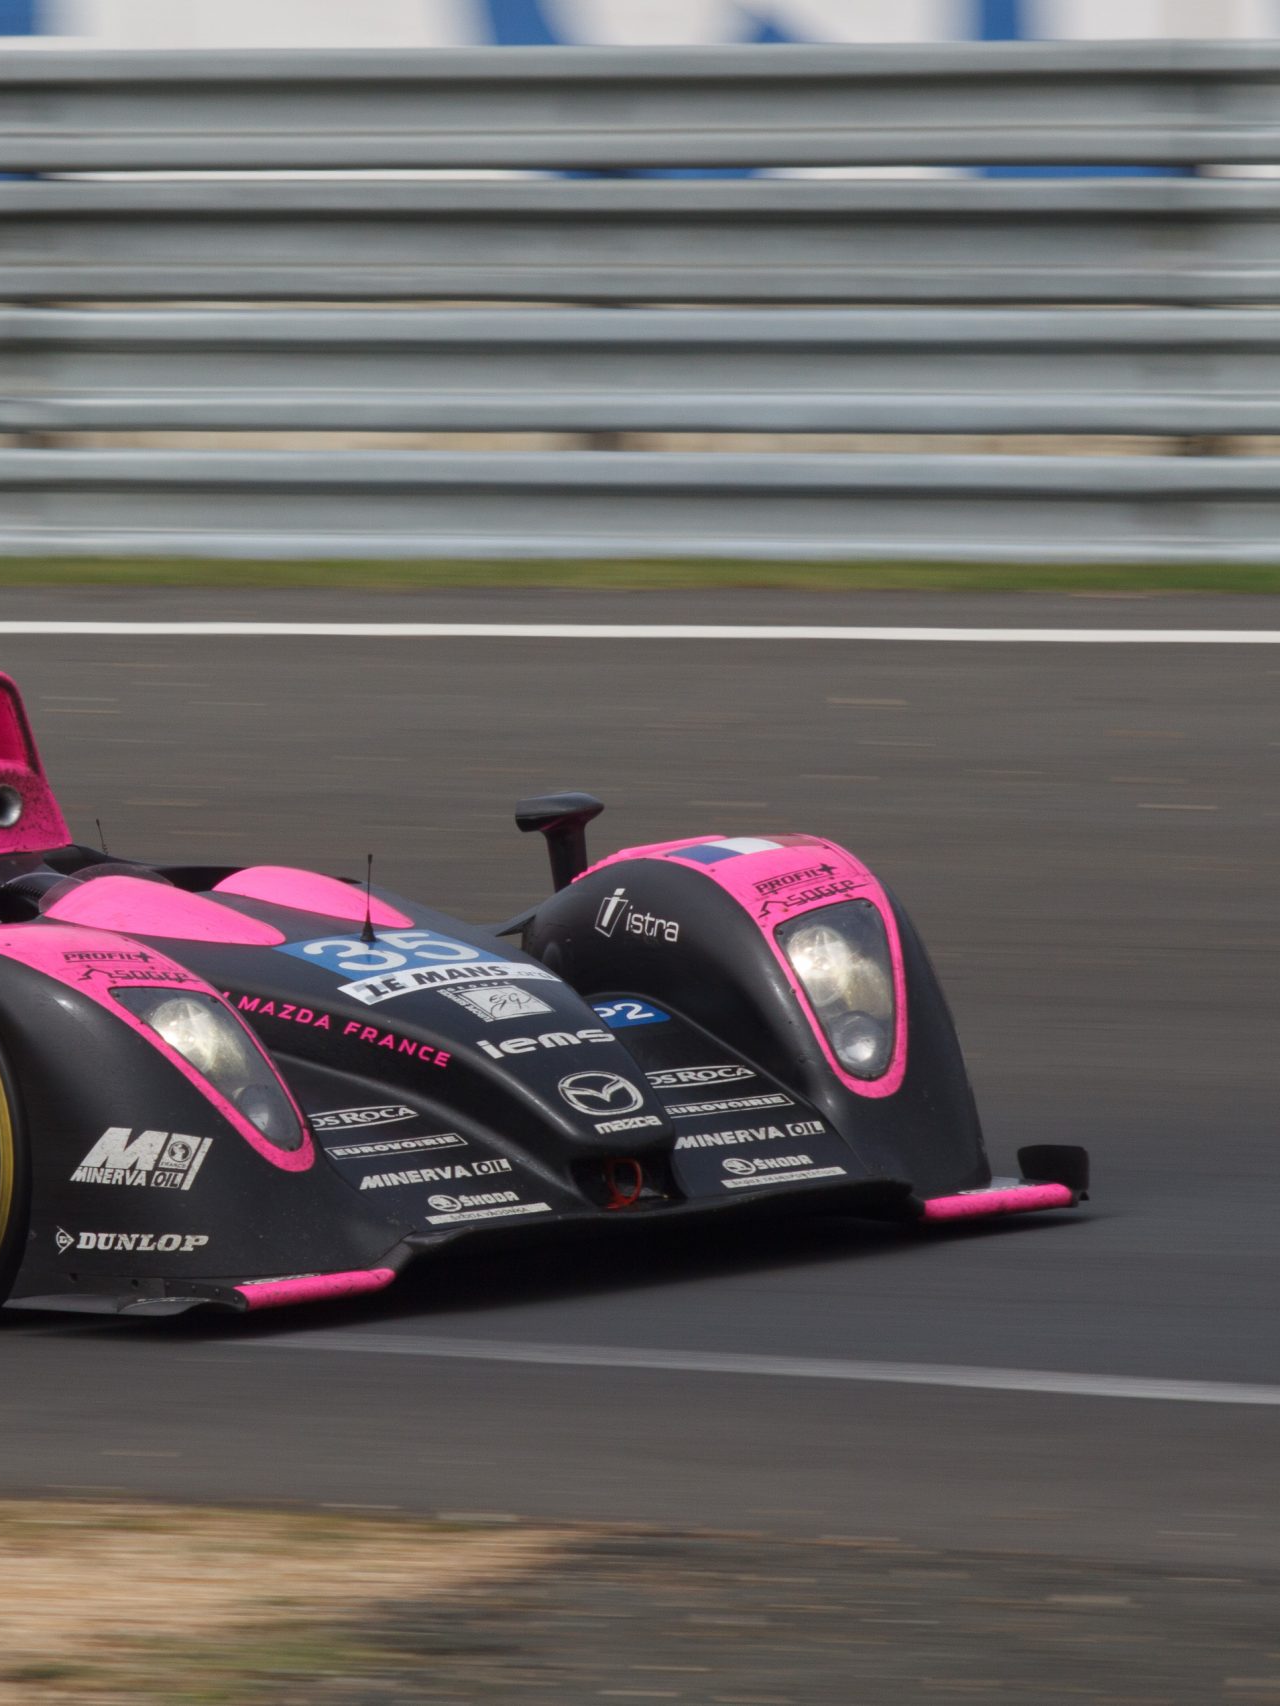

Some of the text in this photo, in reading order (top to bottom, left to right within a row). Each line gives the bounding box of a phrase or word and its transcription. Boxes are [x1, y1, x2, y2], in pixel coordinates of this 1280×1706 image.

[626, 905, 680, 942] istra
[303, 932, 480, 971] 35
[366, 978, 402, 998] LE
[410, 965, 509, 985] MANS
[237, 995, 452, 1067] MAZDA FRANCE
[476, 1028, 616, 1059] iems
[593, 1115, 663, 1134] mazda
[674, 1121, 824, 1149] MINERVA OIL
[70, 1167, 182, 1188] MINERVA OIL
[359, 1159, 510, 1190] MINERVA OIL
[76, 1231, 210, 1251] DUNLOP
